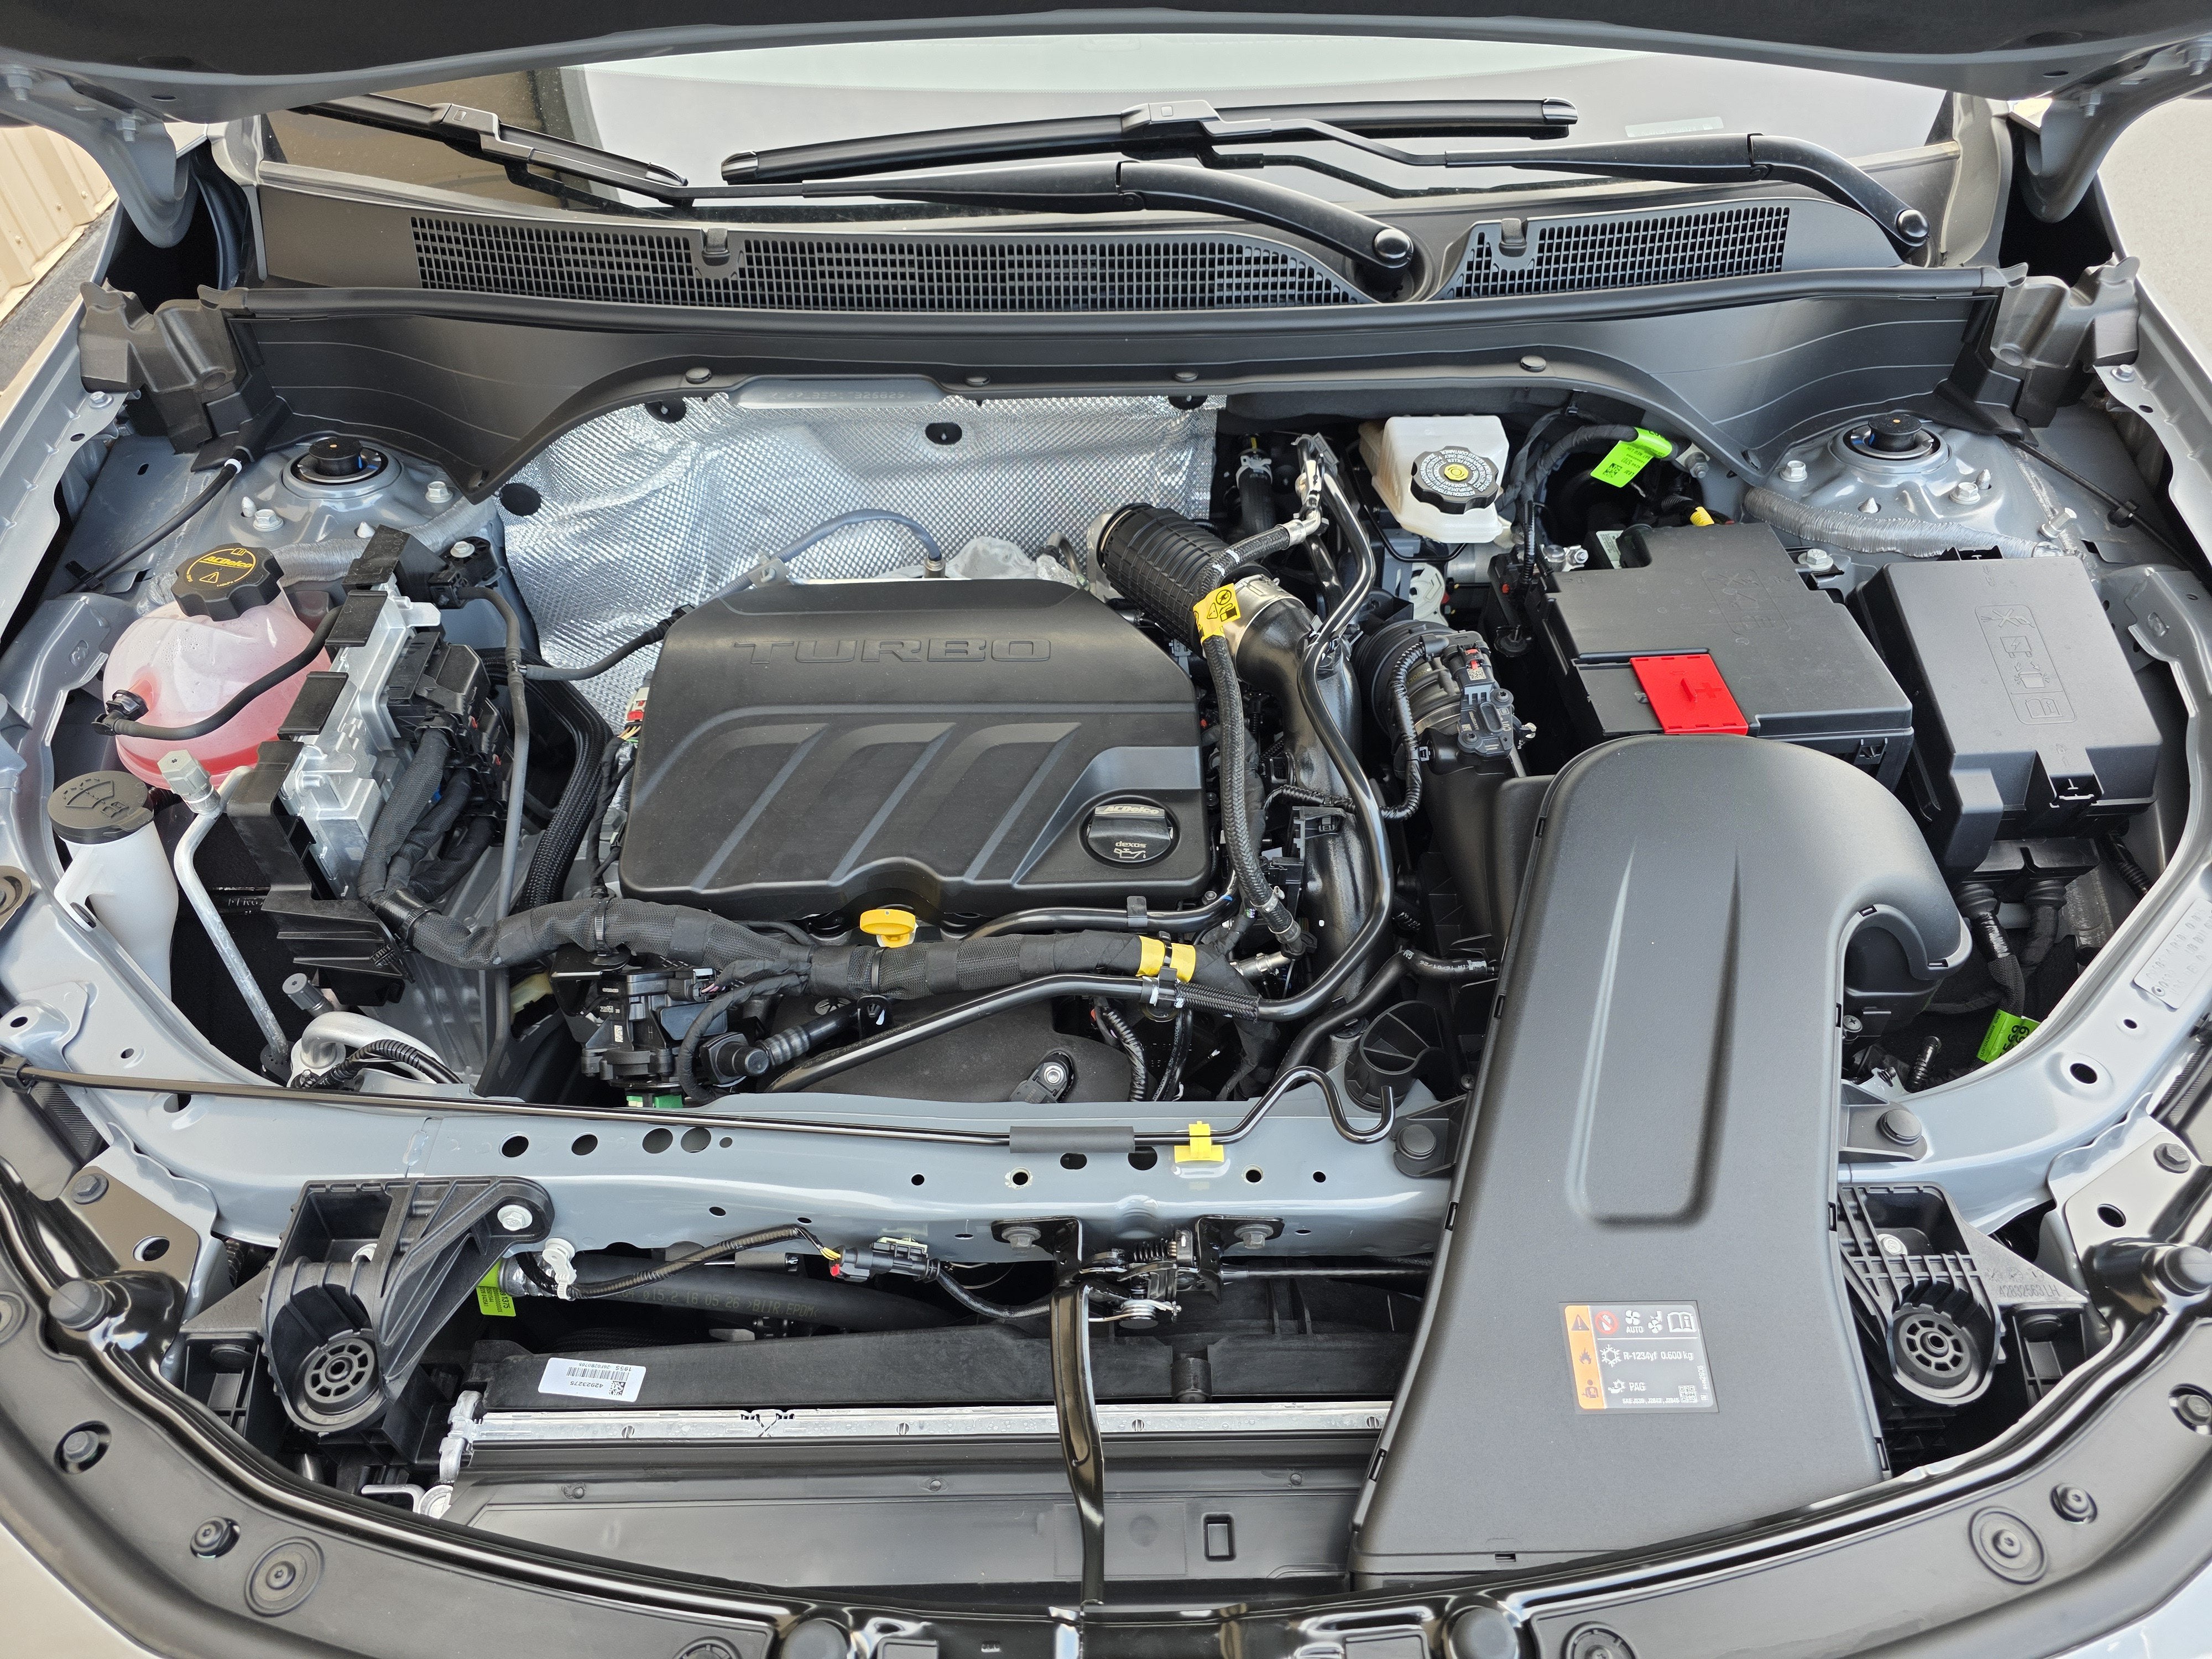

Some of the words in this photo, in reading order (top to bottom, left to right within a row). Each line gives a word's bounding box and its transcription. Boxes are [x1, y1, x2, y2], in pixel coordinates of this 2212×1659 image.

[1462, 460, 1477, 470] CLEAN
[204, 556, 253, 568] ACDelco
[734, 638, 1052, 665] TURBO
[1103, 806, 1160, 815] ACDelco
[1403, 950, 1415, 959] GM
[1999, 1285, 2044, 1297] 42832563
[2043, 1285, 2060, 1297] LH
[502, 1297, 510, 1308] 1375
[686, 1292, 698, 1305] 16
[705, 1293, 719, 1307] 05
[726, 1296, 740, 1309] 26
[1623, 1352, 1657, 1361] R-1234yf
[1682, 1351, 1694, 1361] kg
[1629, 1382, 1646, 1391] PAG
